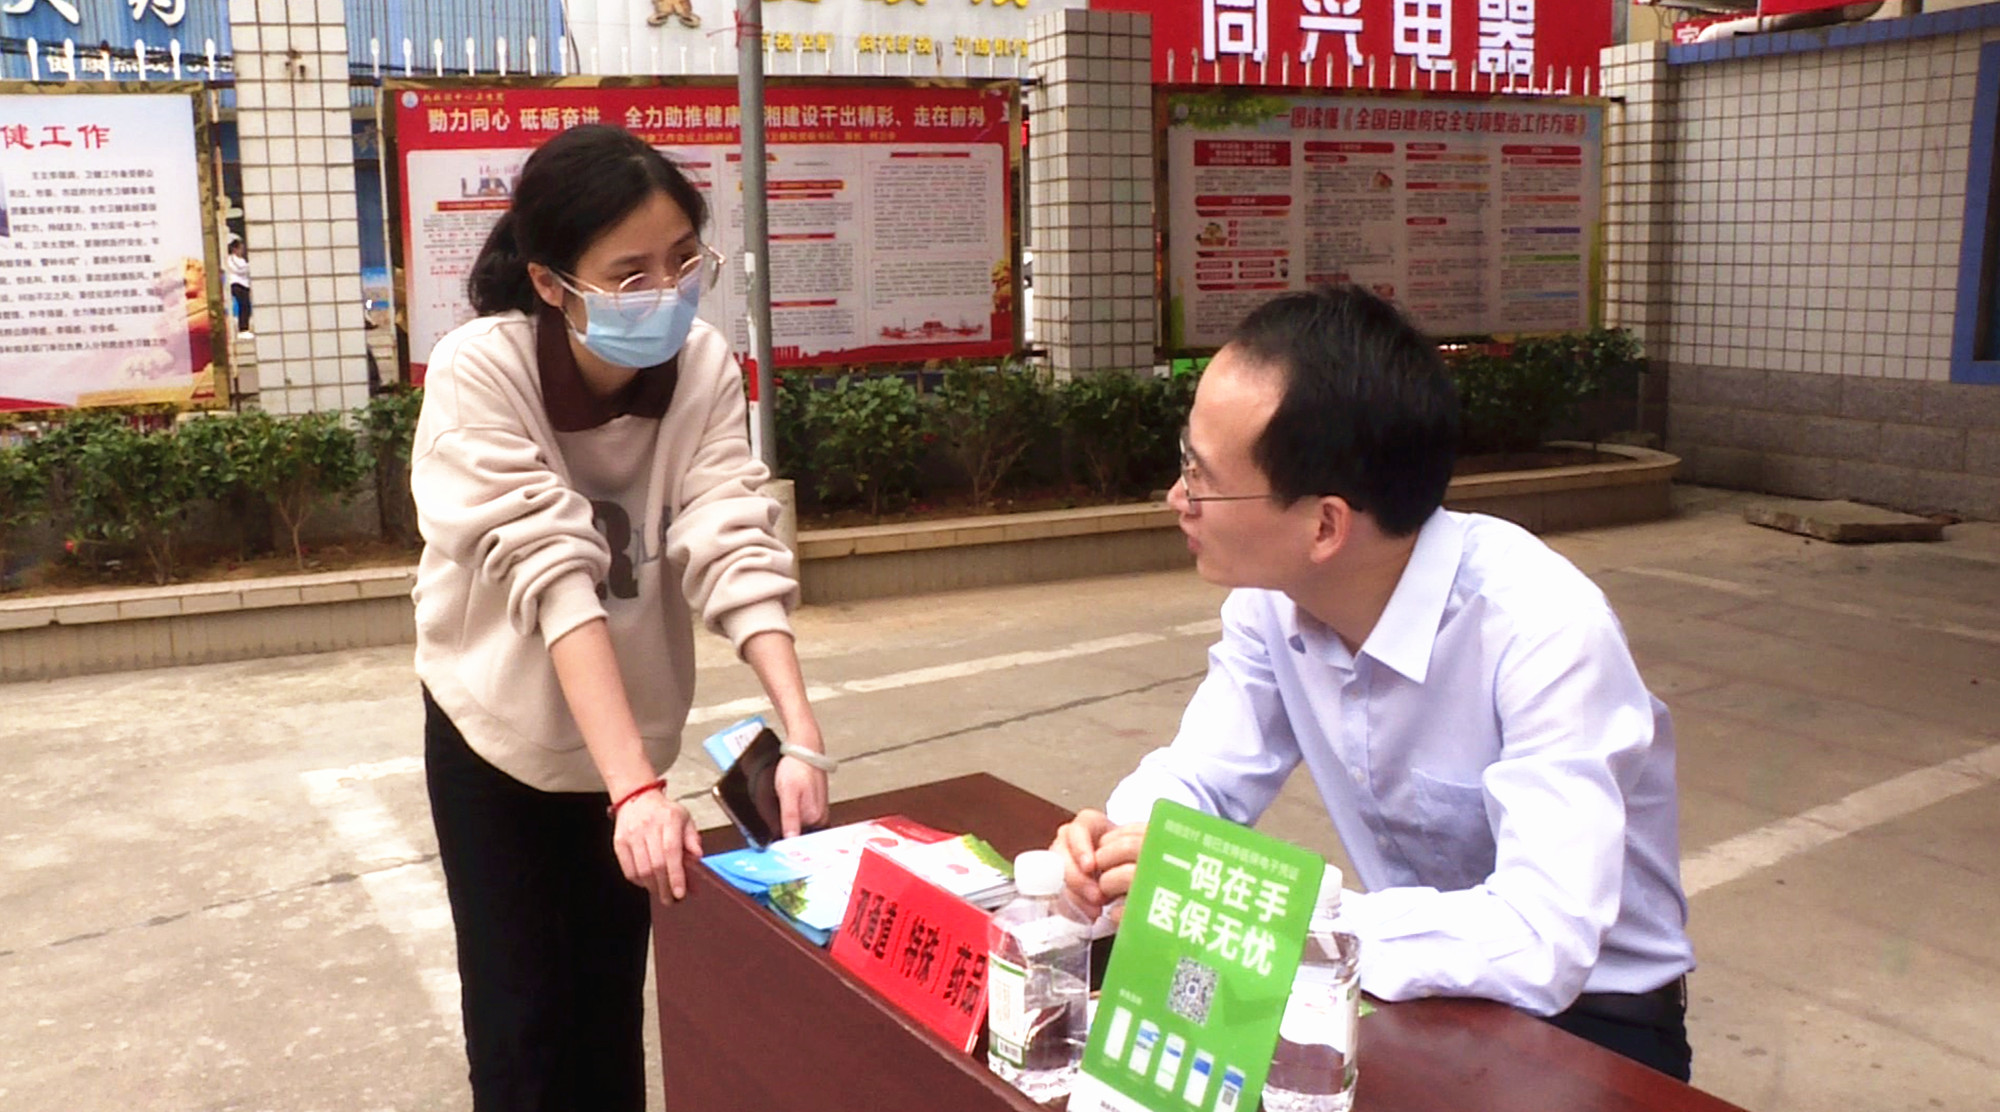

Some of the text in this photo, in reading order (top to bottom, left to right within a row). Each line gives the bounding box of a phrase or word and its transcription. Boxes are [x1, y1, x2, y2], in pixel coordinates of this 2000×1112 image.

[625, 104, 985, 130] 全力助推健康湘建设干出精彩、走在前列
[1162, 852, 1290, 923] 一码在手
[848, 888, 898, 959] 双通道
[900, 915, 940, 986] 特殊
[943, 942, 988, 1017] 药品
[1147, 886, 1276, 977] 医保无忧
